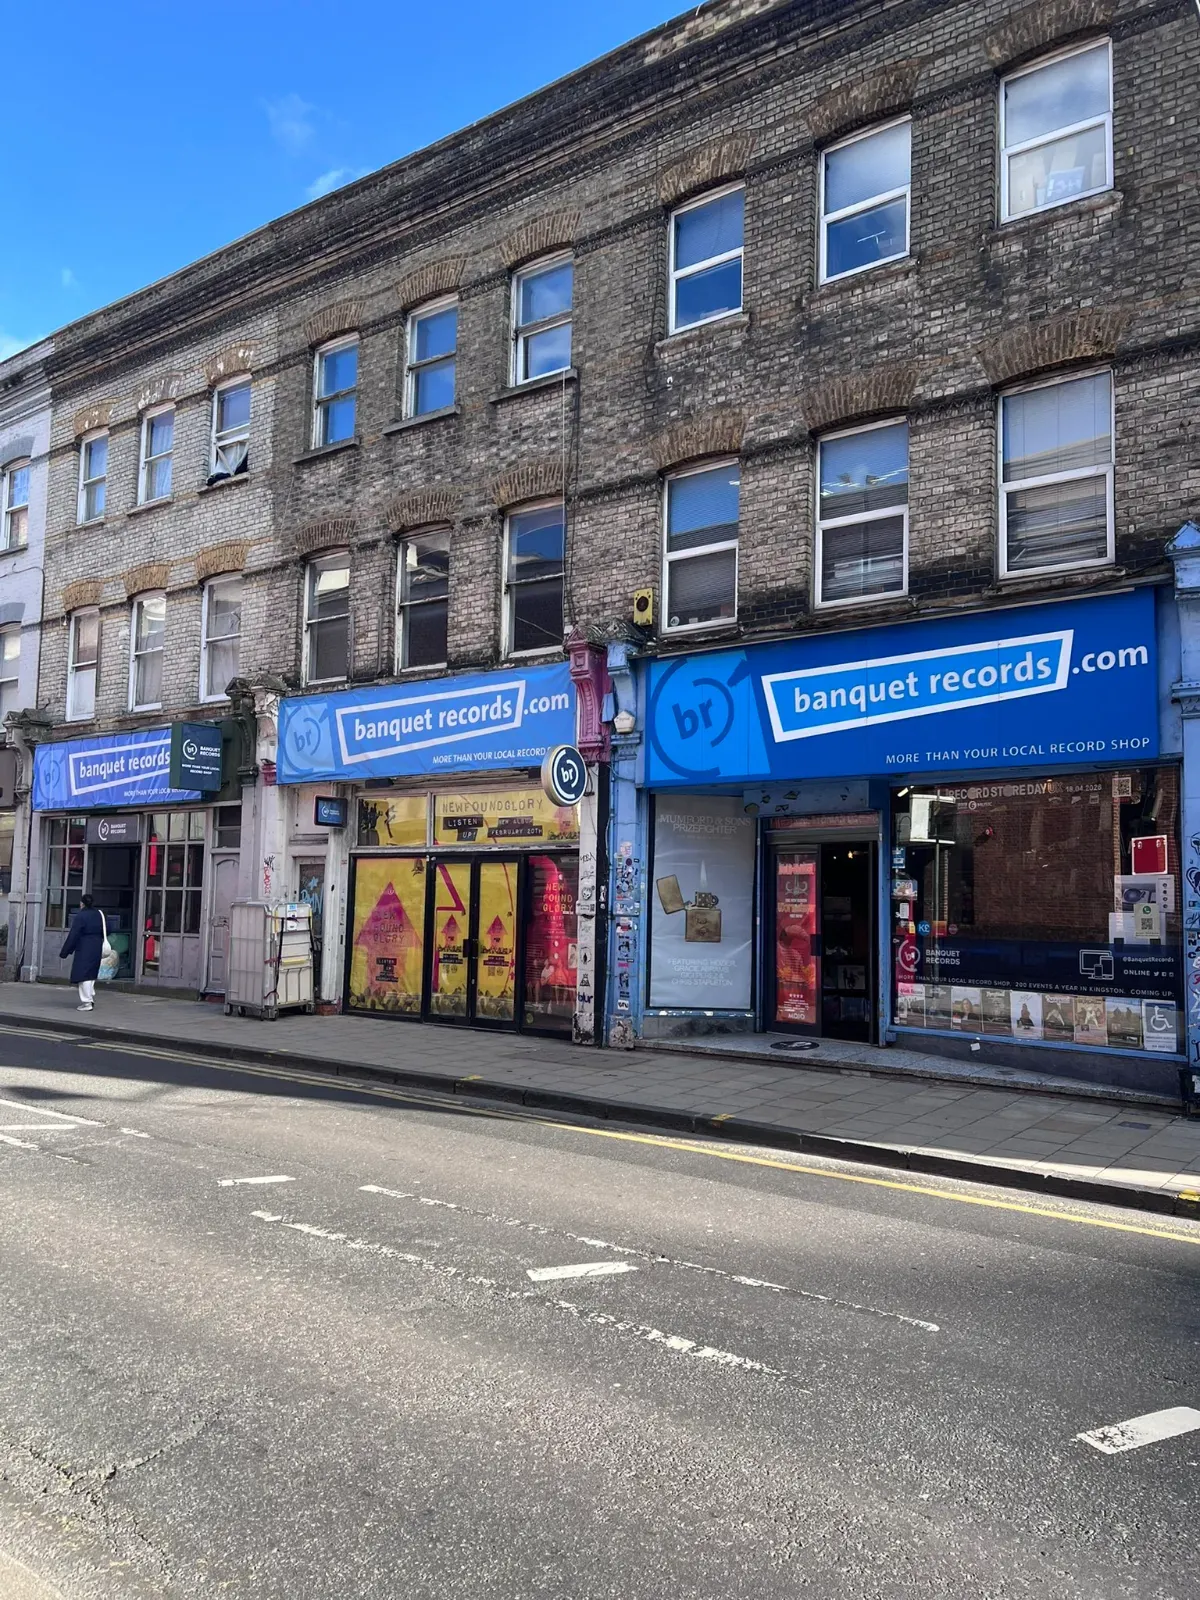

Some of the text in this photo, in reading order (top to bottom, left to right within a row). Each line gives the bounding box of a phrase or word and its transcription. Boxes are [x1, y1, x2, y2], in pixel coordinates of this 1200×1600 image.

[793, 645, 1149, 713] banquet records .com
[354, 693, 569, 741] banquet records .com
[672, 701, 715, 741] br
[293, 728, 312, 750] br
[433, 754, 452, 764] MORE
[453, 753, 472, 763] THAN
[473, 751, 492, 761] YOUR
[493, 750, 516, 759] LOCAL
[517, 747, 546, 757] RECORD
[886, 737, 1150, 764] MORE THAN YOUR LOCAL RECORD SHOP
[79, 748, 170, 779] banquet records
[561, 767, 573, 783] br
[950, 786, 990, 800] RECORD
[991, 784, 1026, 798] STORE
[1027, 782, 1047, 795] DAY
[447, 818, 478, 827] LISTEN
[660, 814, 714, 824] MUMFORD
[725, 817, 751, 827] SONS
[491, 827, 523, 836] FEBRUARY
[546, 883, 565, 892] NEW
[543, 894, 573, 903] FOUND
[543, 904, 573, 913] GLORY
[926, 949, 960, 957] BANQUET
[926, 957, 960, 965] RECORDS
[1028, 982, 1053, 990] EVENTS
[1089, 986, 1125, 994] KINGSTON.
[1130, 988, 1160, 997] COMING
